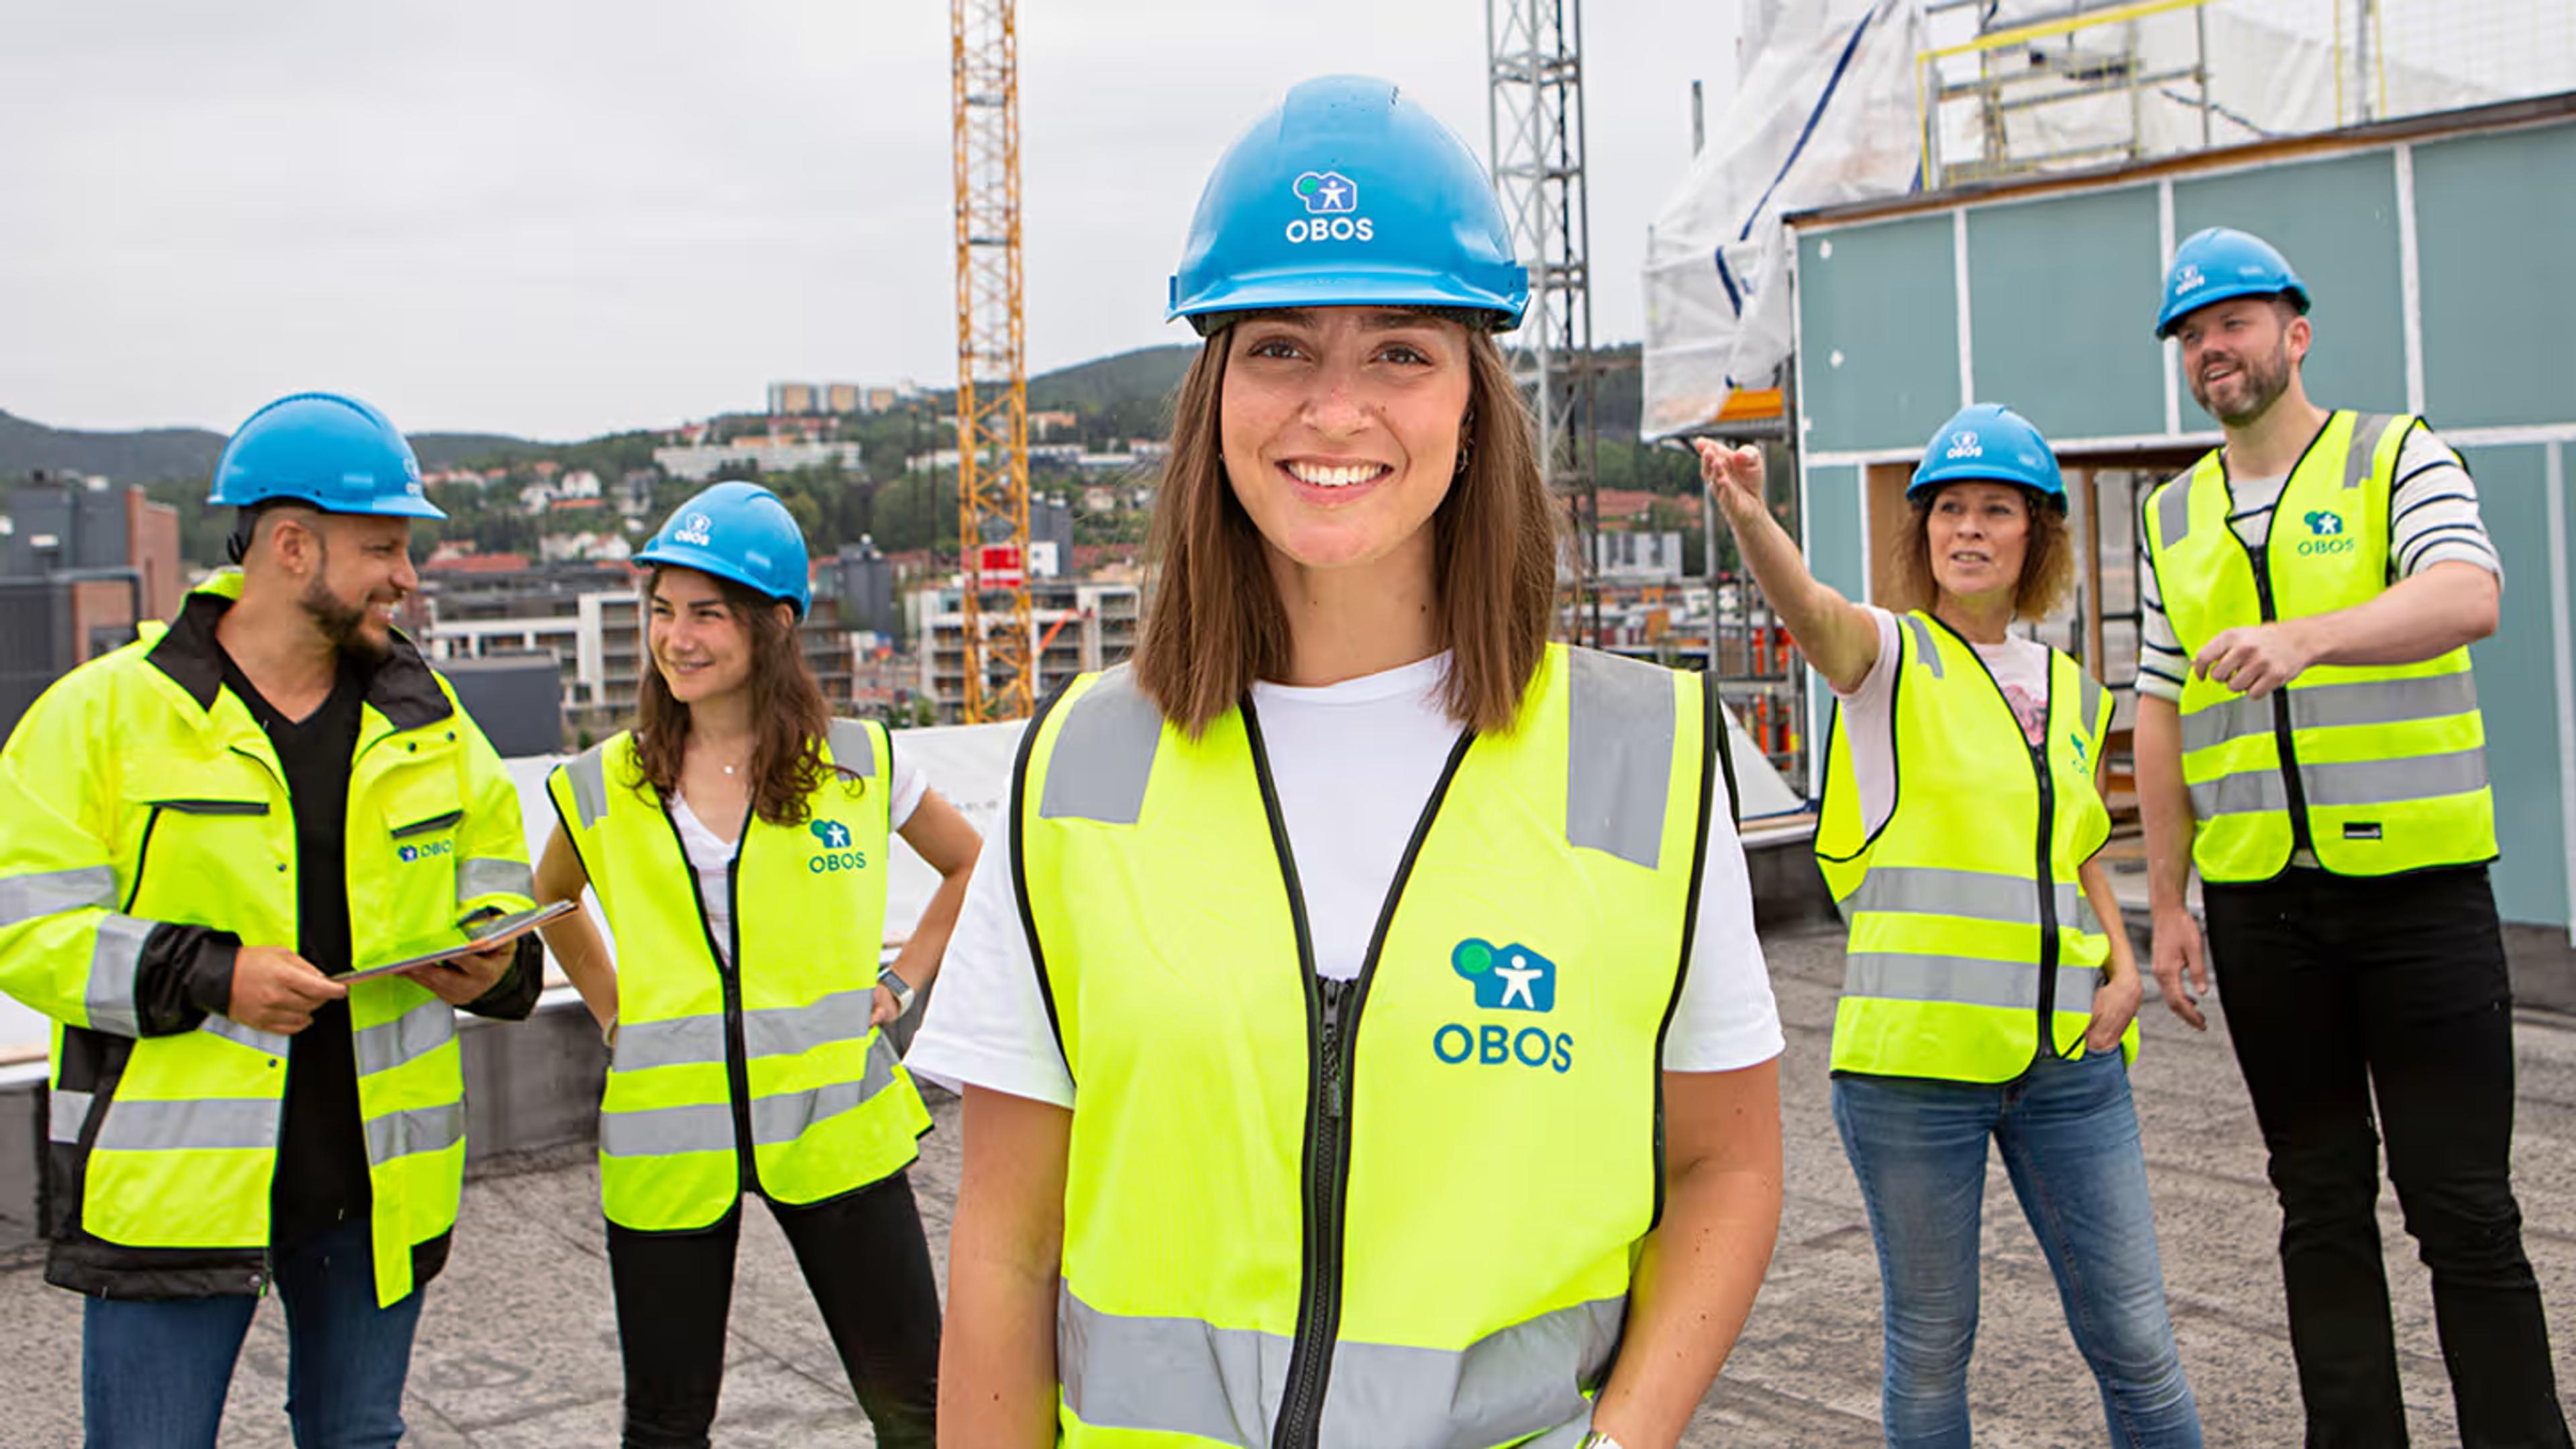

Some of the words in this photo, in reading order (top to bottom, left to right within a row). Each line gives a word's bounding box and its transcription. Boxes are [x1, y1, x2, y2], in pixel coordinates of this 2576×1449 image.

[1285, 216, 1374, 244] OBOS
[2297, 537, 2355, 556] OBOS
[421, 839, 452, 857] OBO
[809, 851, 867, 873] OBOS
[1433, 1022, 1574, 1074] OBOS
